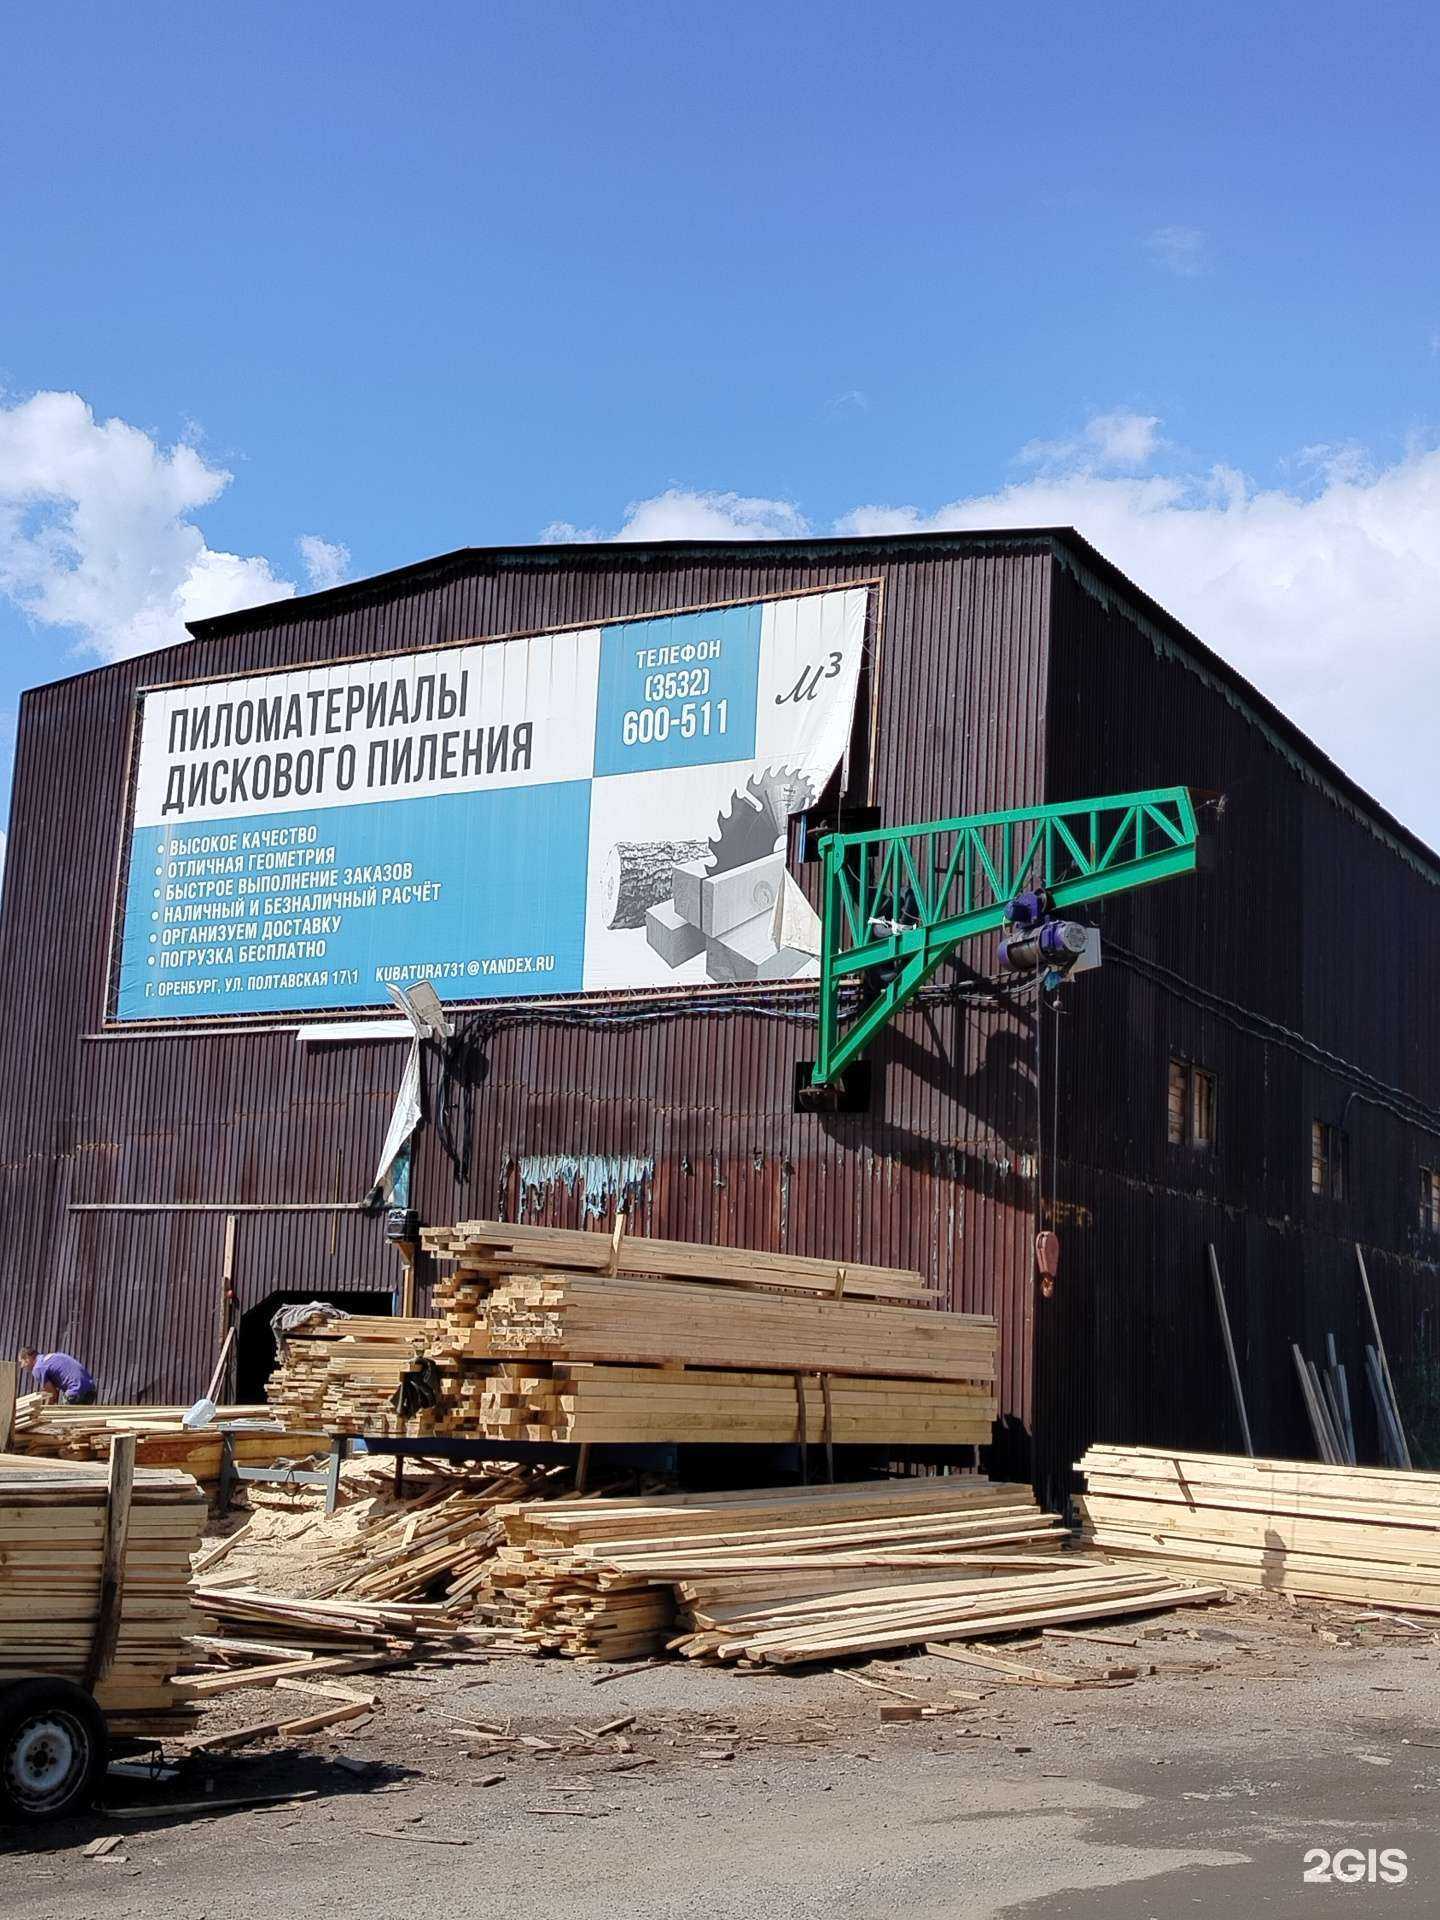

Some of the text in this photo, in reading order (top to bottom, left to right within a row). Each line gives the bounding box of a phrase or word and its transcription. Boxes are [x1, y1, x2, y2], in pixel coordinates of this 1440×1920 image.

[636, 640, 721, 669] ТЕЛЕФОН
[644, 668, 710, 702] (3532)
[168, 670, 469, 754] ПИЛОМАТЕРИАЛЫ
[622, 699, 728, 746] 600-511
[161, 722, 534, 815] ДИСКОВОГО ПИЛЕНИЯ
[169, 825, 317, 856] ВЫСОКОЕ КАЧЕСТВО
[167, 847, 335, 879] ОТЛИЧНАЯ ГЕОМЕТРИЯ
[165, 862, 413, 901] БЫСТРОЕ ВЫПОЛНЕНИЕ ЗАКАЗОВ
[164, 881, 442, 923] НАЛИЧНЫЙ И БЕЗНАЛИЧНЫЙ РАСЧЁТ
[162, 915, 342, 946] ОРГАНИЗУЕМ ДОСТАВКУ
[160, 940, 326, 969] ПОГРУЗКА БЕСПЛАТНО
[145, 983, 155, 997] Г.
[158, 978, 221, 997] ОРЕНБУРГ,
[224, 976, 244, 993] УЛ.
[248, 971, 328, 991] ПОЛТАВСКАЯ
